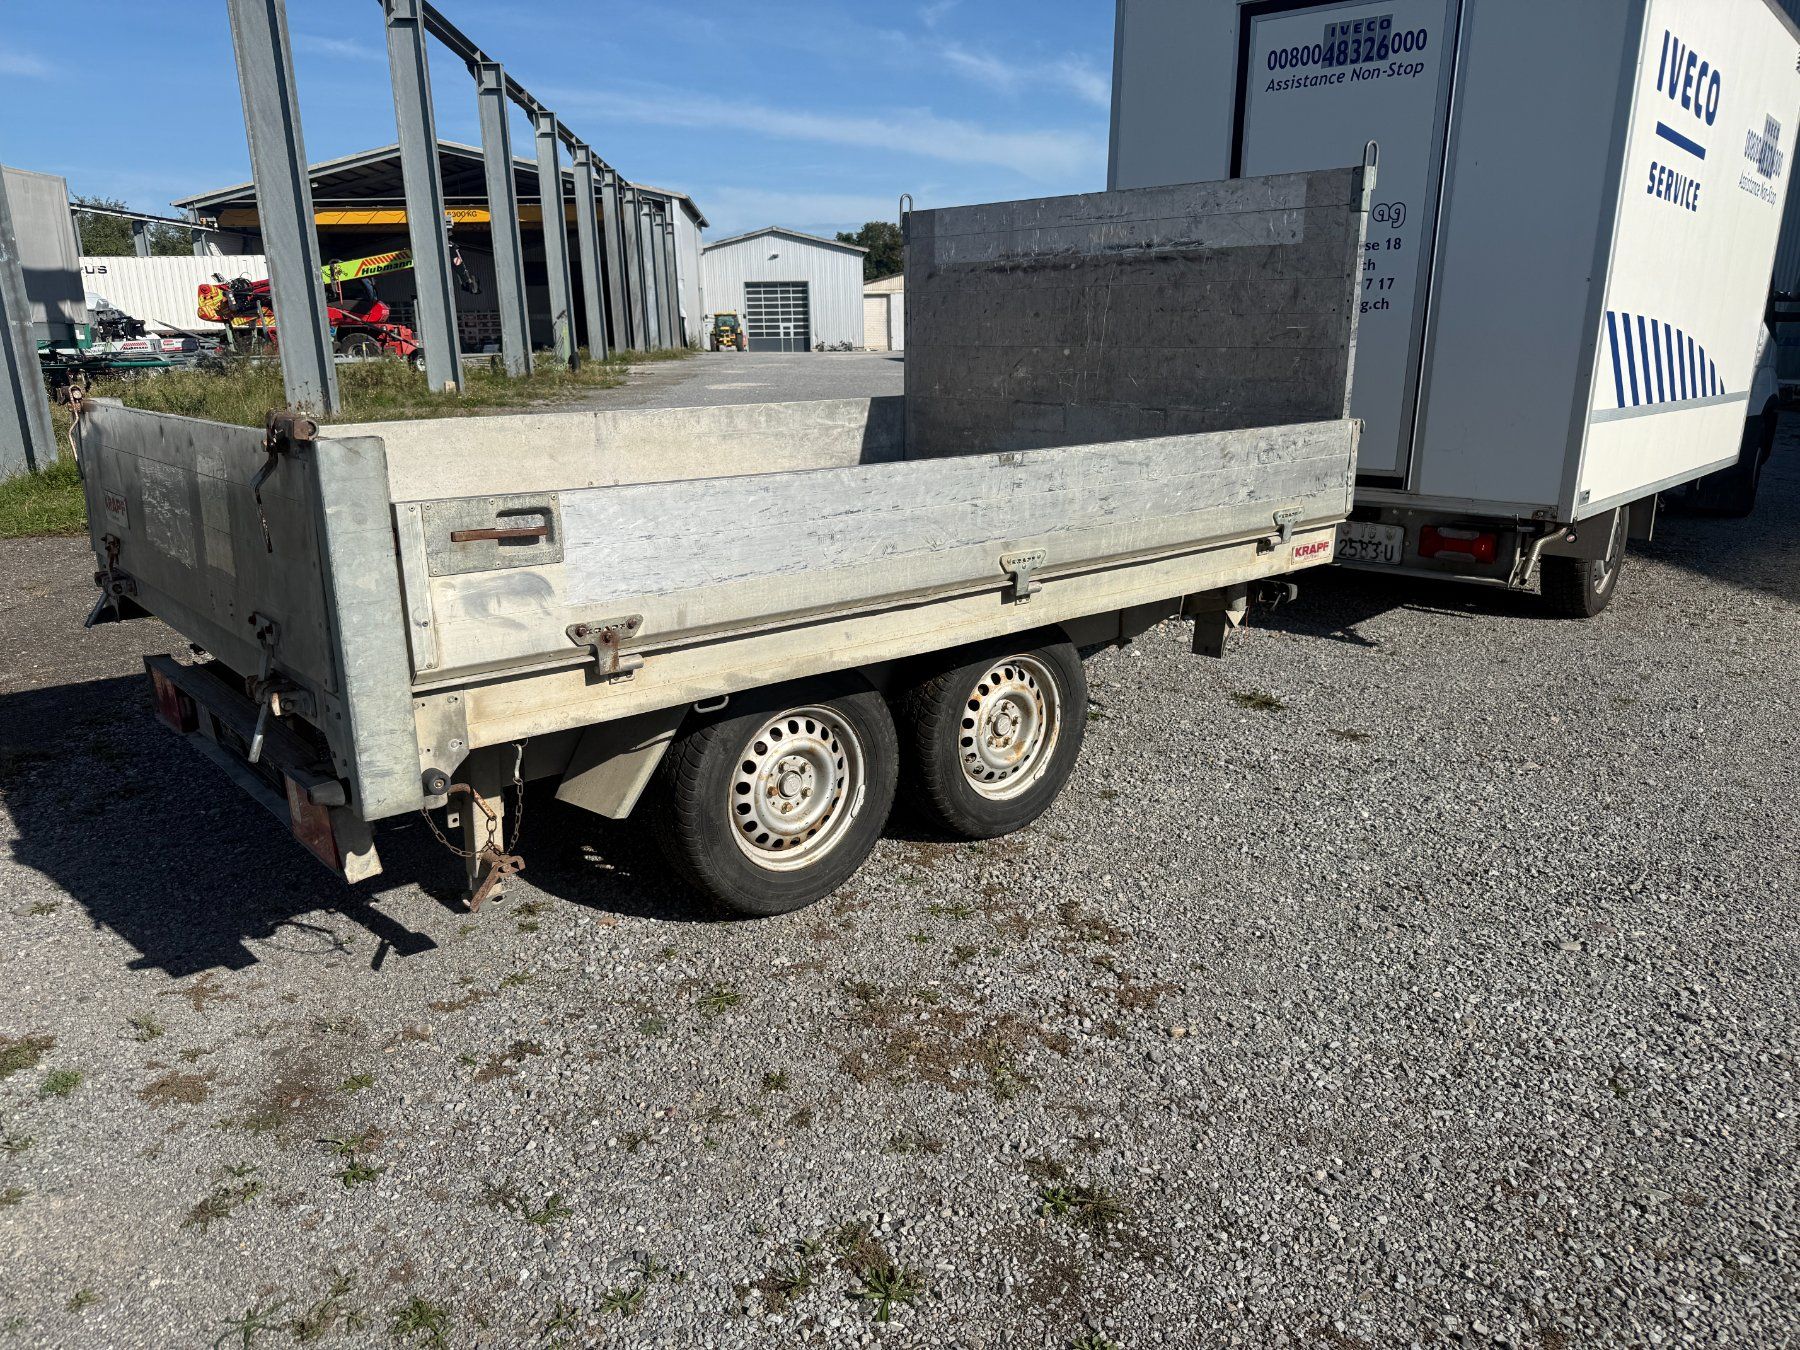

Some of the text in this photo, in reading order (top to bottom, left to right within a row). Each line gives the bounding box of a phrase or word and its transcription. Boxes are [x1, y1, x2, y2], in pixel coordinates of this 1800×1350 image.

[1330, 18, 1391, 38] IVECO
[1267, 28, 1428, 71] 0080048326000
[1265, 61, 1425, 93] Assistance Non-Stop
[1656, 28, 1721, 127] IVECO
[1646, 161, 1701, 213] SERVICE
[1364, 237, 1402, 251] se 18
[81, 265, 108, 275] US
[361, 260, 413, 276] Hubmann
[1365, 277, 1395, 290] 7 17
[1360, 297, 1389, 314] g.ch
[1295, 542, 1329, 557] KRAPF
